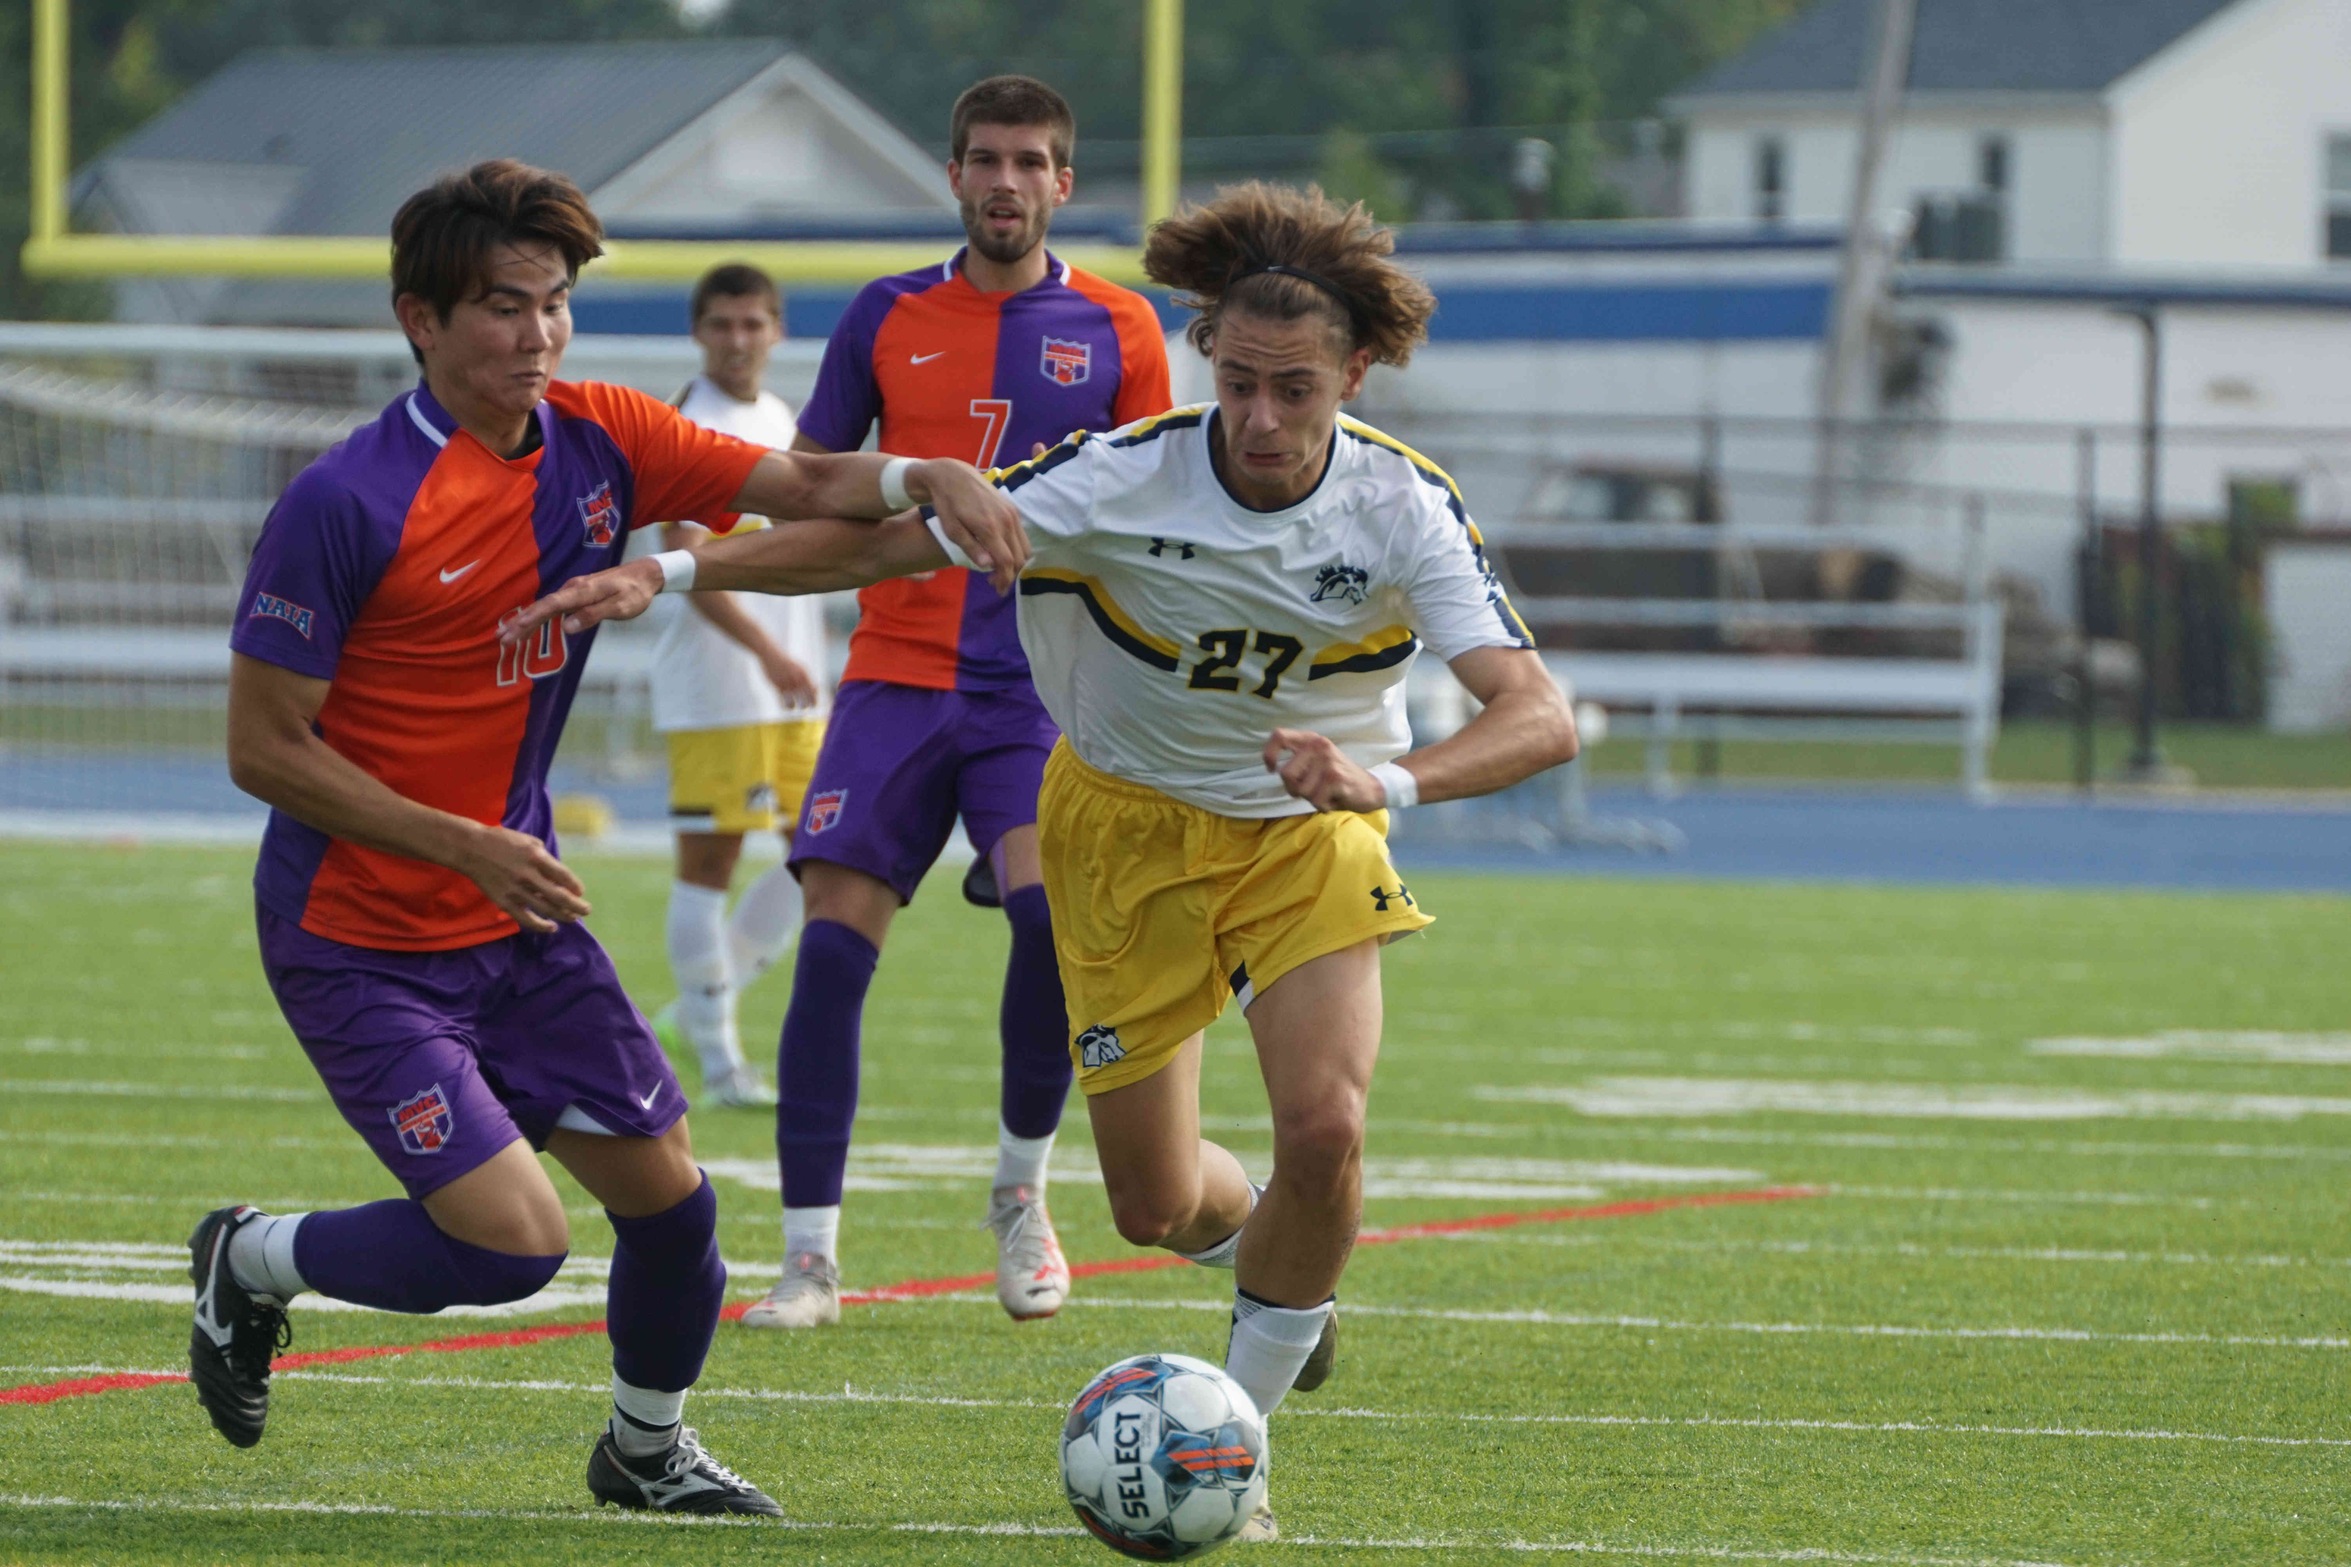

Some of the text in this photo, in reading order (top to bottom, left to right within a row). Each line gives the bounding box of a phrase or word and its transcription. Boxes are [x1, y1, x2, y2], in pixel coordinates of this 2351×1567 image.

[969, 399, 1012, 472] 7
[249, 591, 315, 640] NAIA
[1187, 629, 1304, 700] 27
[398, 1095, 438, 1122] MVC
[1114, 1411, 1150, 1519] SELECT
